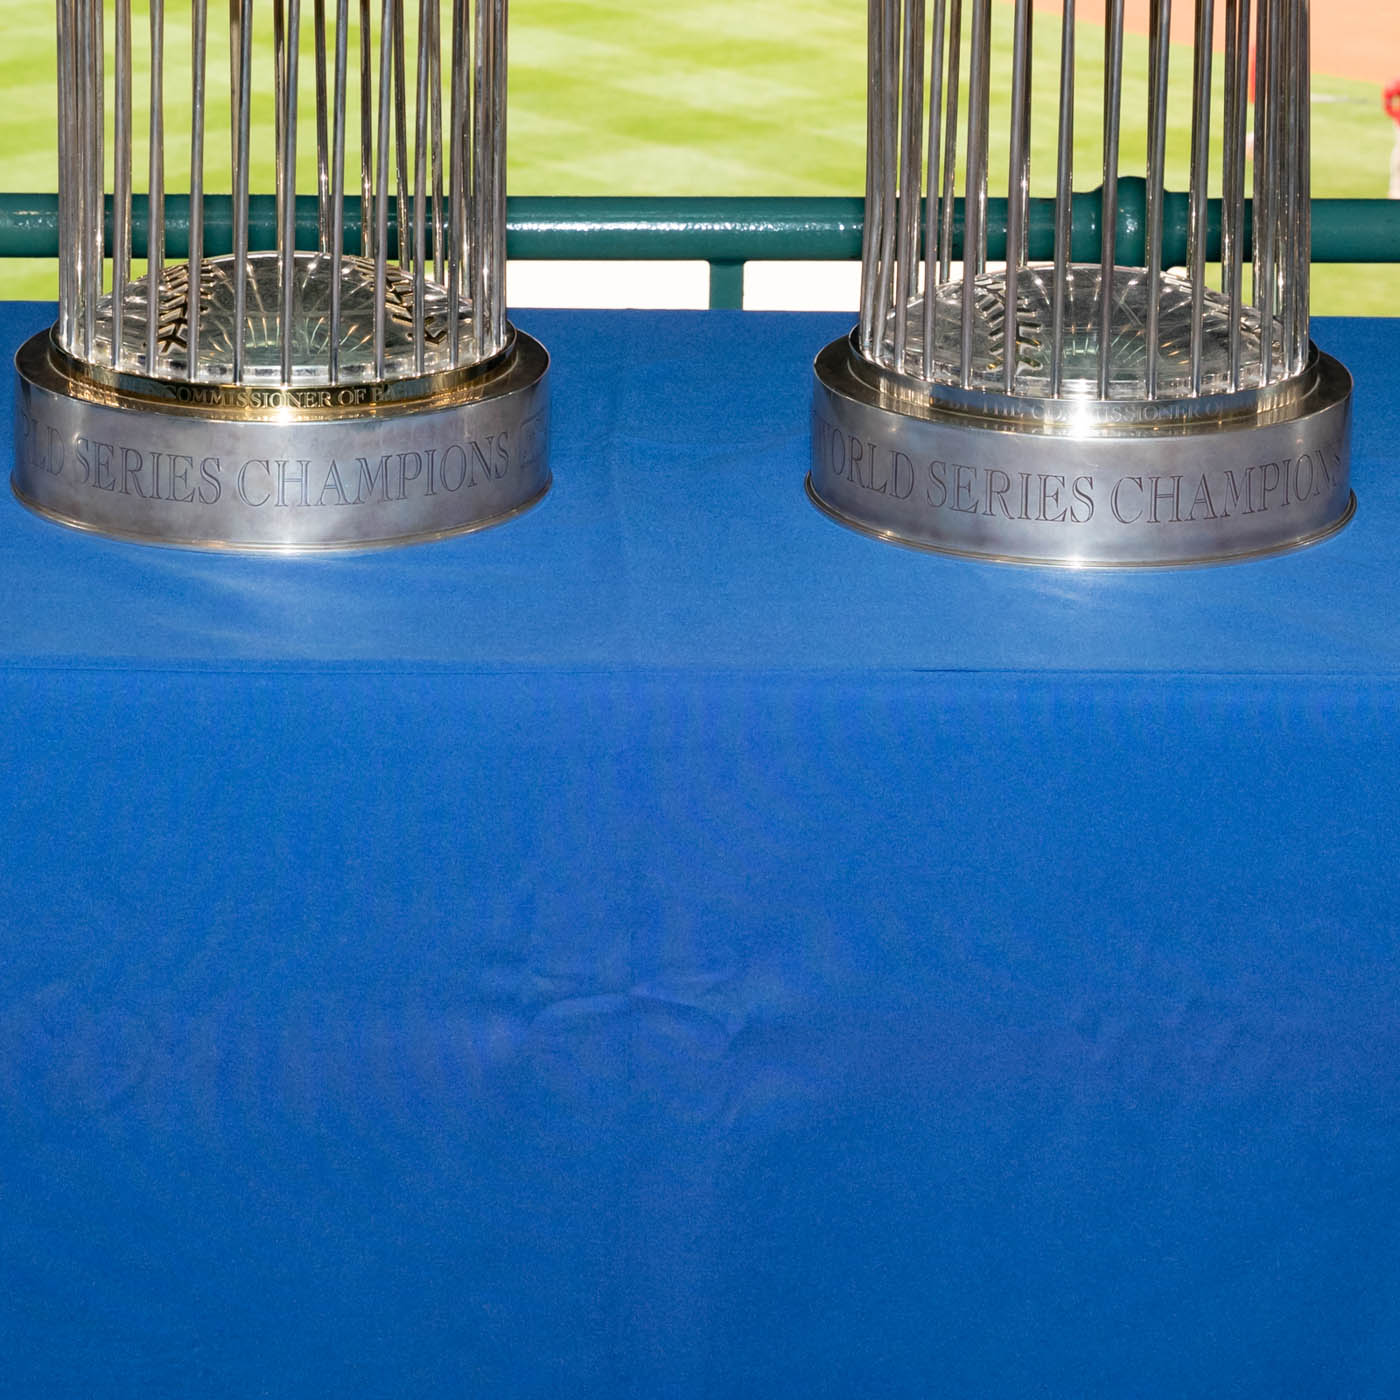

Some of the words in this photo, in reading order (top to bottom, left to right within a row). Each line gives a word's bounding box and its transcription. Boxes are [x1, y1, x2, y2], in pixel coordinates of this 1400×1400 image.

[338, 388, 367, 407] OF
[74, 436, 222, 505] SERIES
[237, 430, 511, 508] CHAMPIONS
[926, 460, 1095, 524] SERIES
